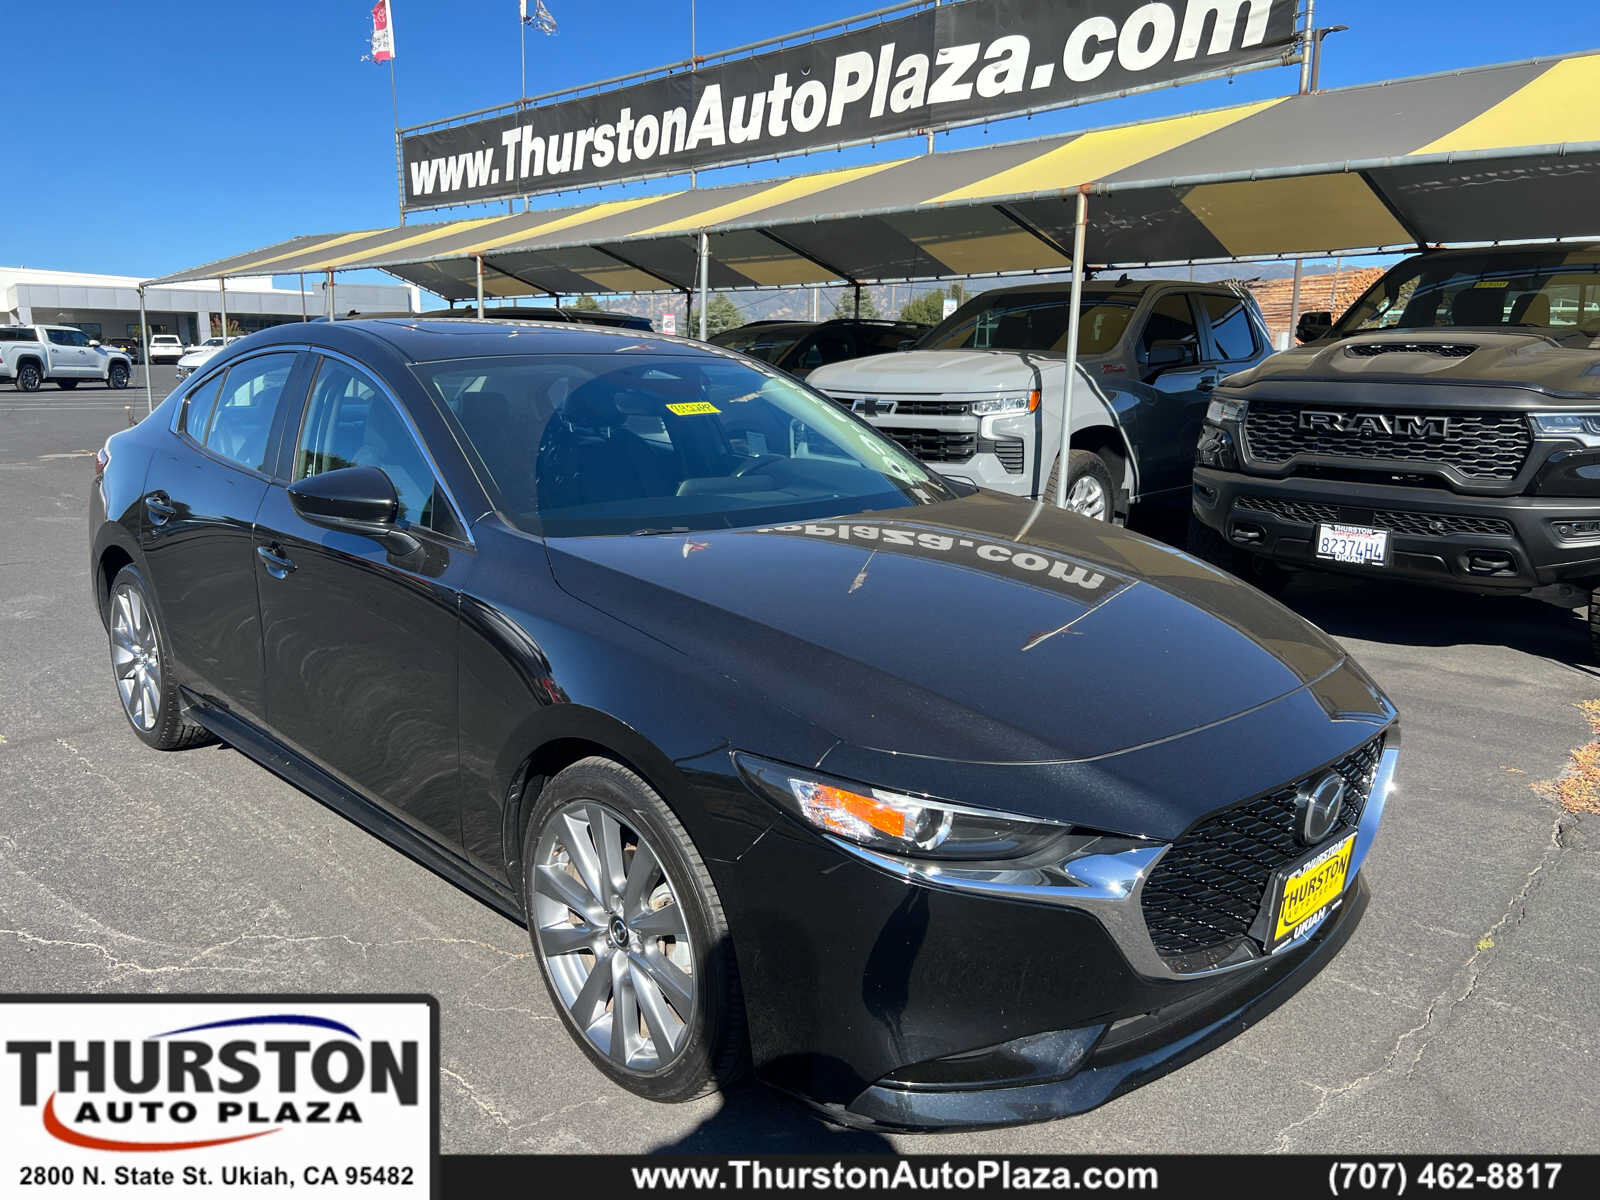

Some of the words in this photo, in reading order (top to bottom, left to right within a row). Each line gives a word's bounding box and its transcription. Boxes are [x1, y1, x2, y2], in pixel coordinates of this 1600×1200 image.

[410, 0, 1272, 196] www.ThurstonAutoPlaza.com
[1299, 410, 1449, 438] RAM
[1321, 537, 1381, 559] 82374H4
[1281, 853, 1349, 919] THURSTON
